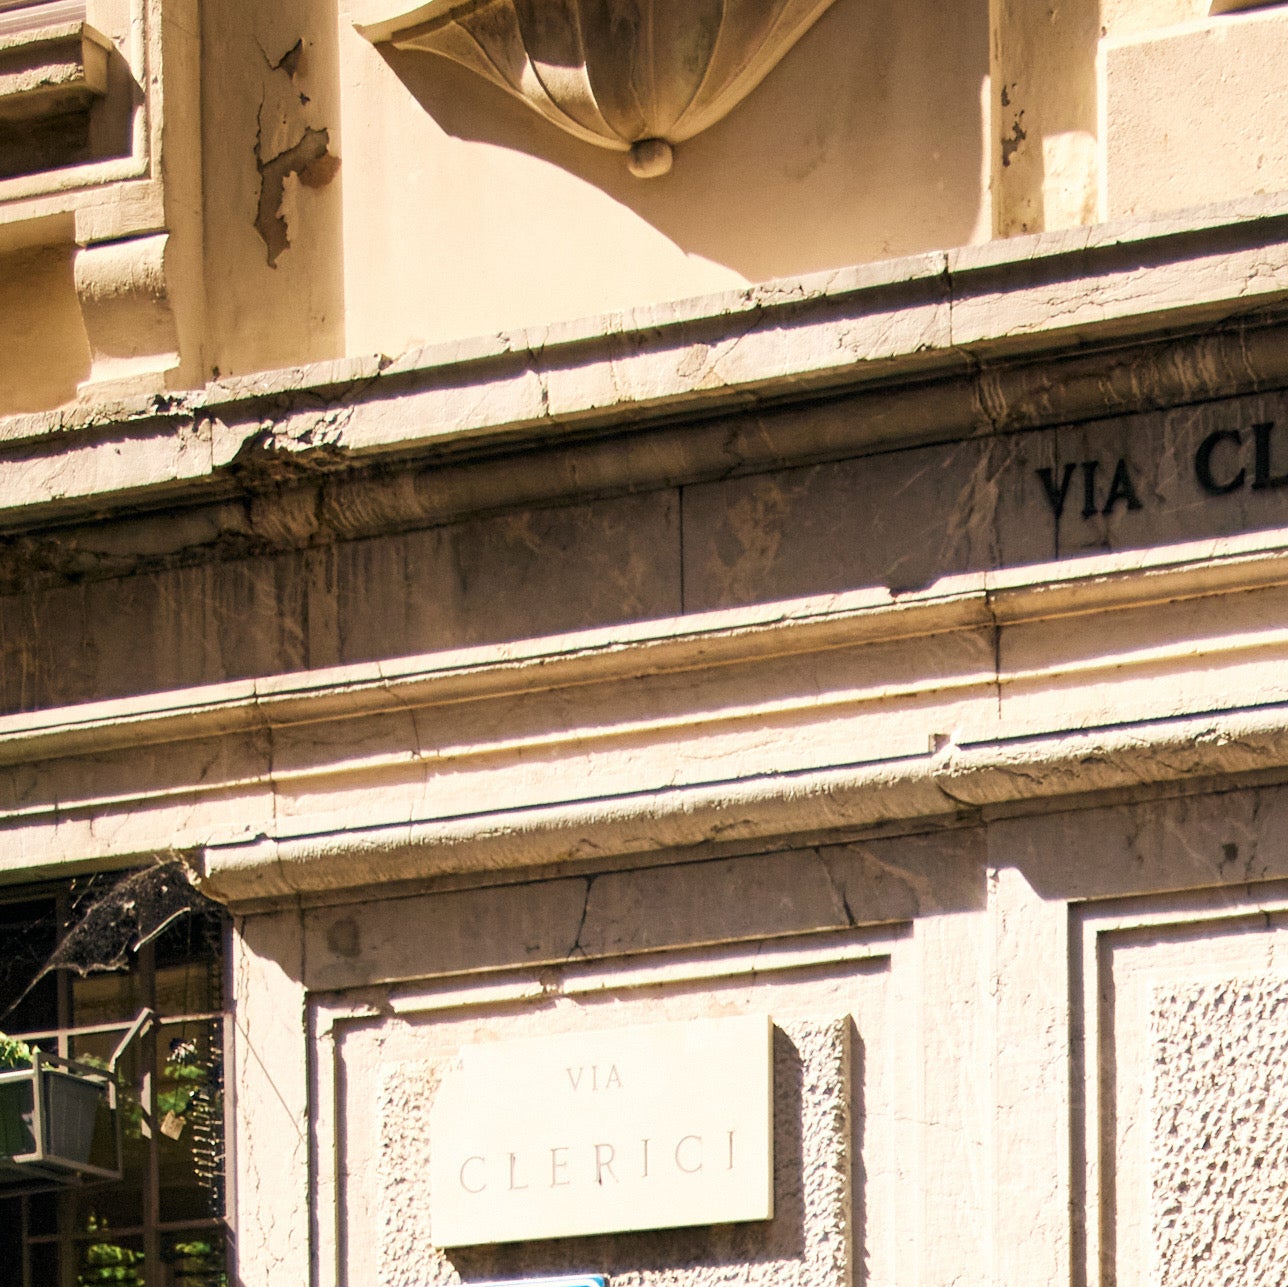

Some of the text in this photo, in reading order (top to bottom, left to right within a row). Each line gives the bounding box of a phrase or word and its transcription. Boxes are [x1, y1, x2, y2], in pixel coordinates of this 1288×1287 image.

[1036, 458, 1143, 521] VIA
[565, 1063, 624, 1092] VIA
[459, 1130, 737, 1194] CLERICI
